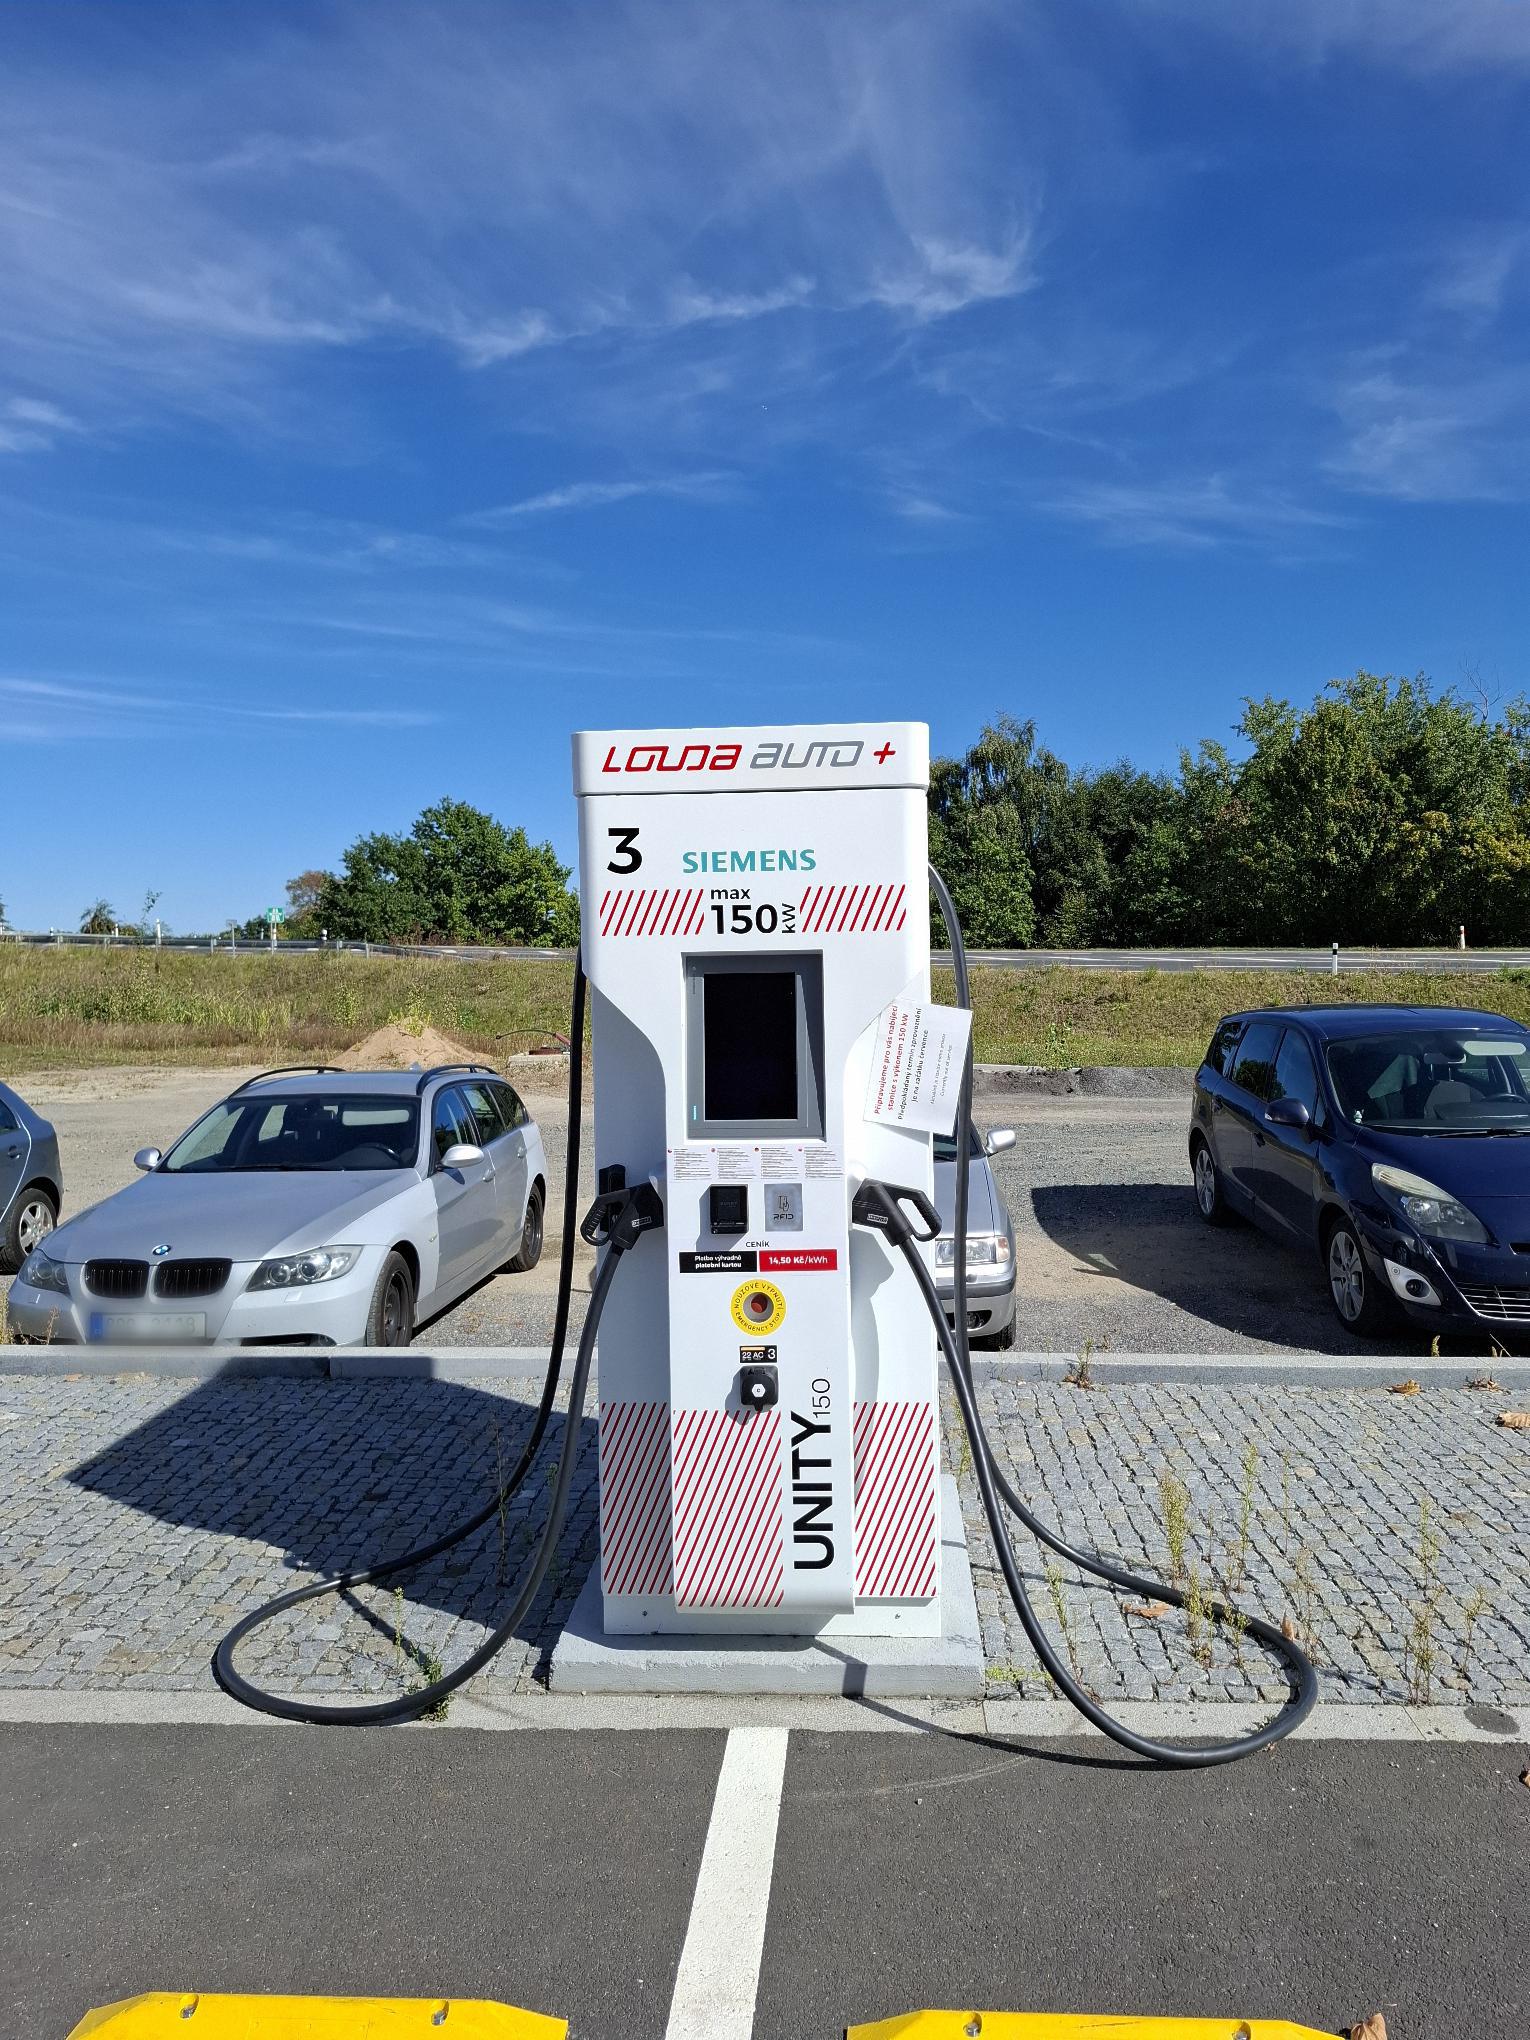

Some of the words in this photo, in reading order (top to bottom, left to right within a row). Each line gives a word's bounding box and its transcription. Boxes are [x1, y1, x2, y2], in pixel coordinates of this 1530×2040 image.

[602, 744, 742, 772] LOUDA
[606, 827, 643, 874] 3
[682, 849, 817, 873] SIEMENS
[710, 888, 750, 900] max
[710, 903, 778, 935] 150
[781, 903, 796, 934] kW
[884, 1050, 892, 1063] pro
[888, 1084, 897, 1110] stanice
[893, 1043, 903, 1077] výkonem
[900, 1013, 909, 1026] kW
[793, 1255, 828, 1264] Kč/kWh
[735, 1311, 768, 1331] EMERGENCY
[769, 1312, 781, 1328] STOP
[768, 1348, 775, 1359] 3
[812, 1378, 831, 1418] 150
[790, 1410, 835, 1569] UNITY
